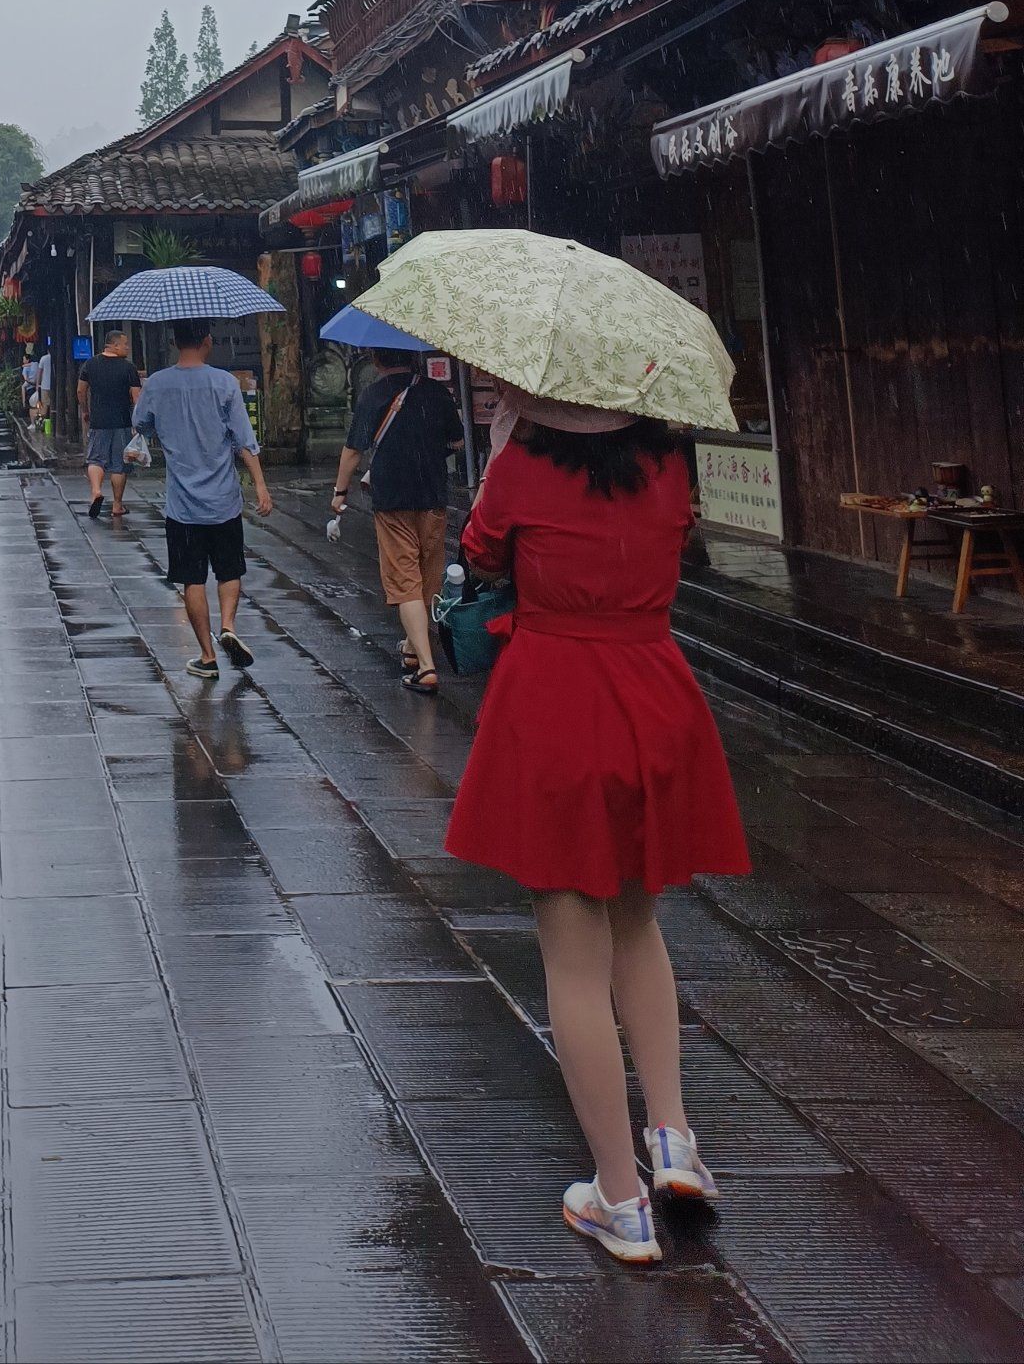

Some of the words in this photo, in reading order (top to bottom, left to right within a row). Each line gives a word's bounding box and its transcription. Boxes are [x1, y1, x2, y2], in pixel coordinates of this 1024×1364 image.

[842, 46, 955, 113] 音乐康养地
[667, 115, 738, 166] 民乐文创谷
